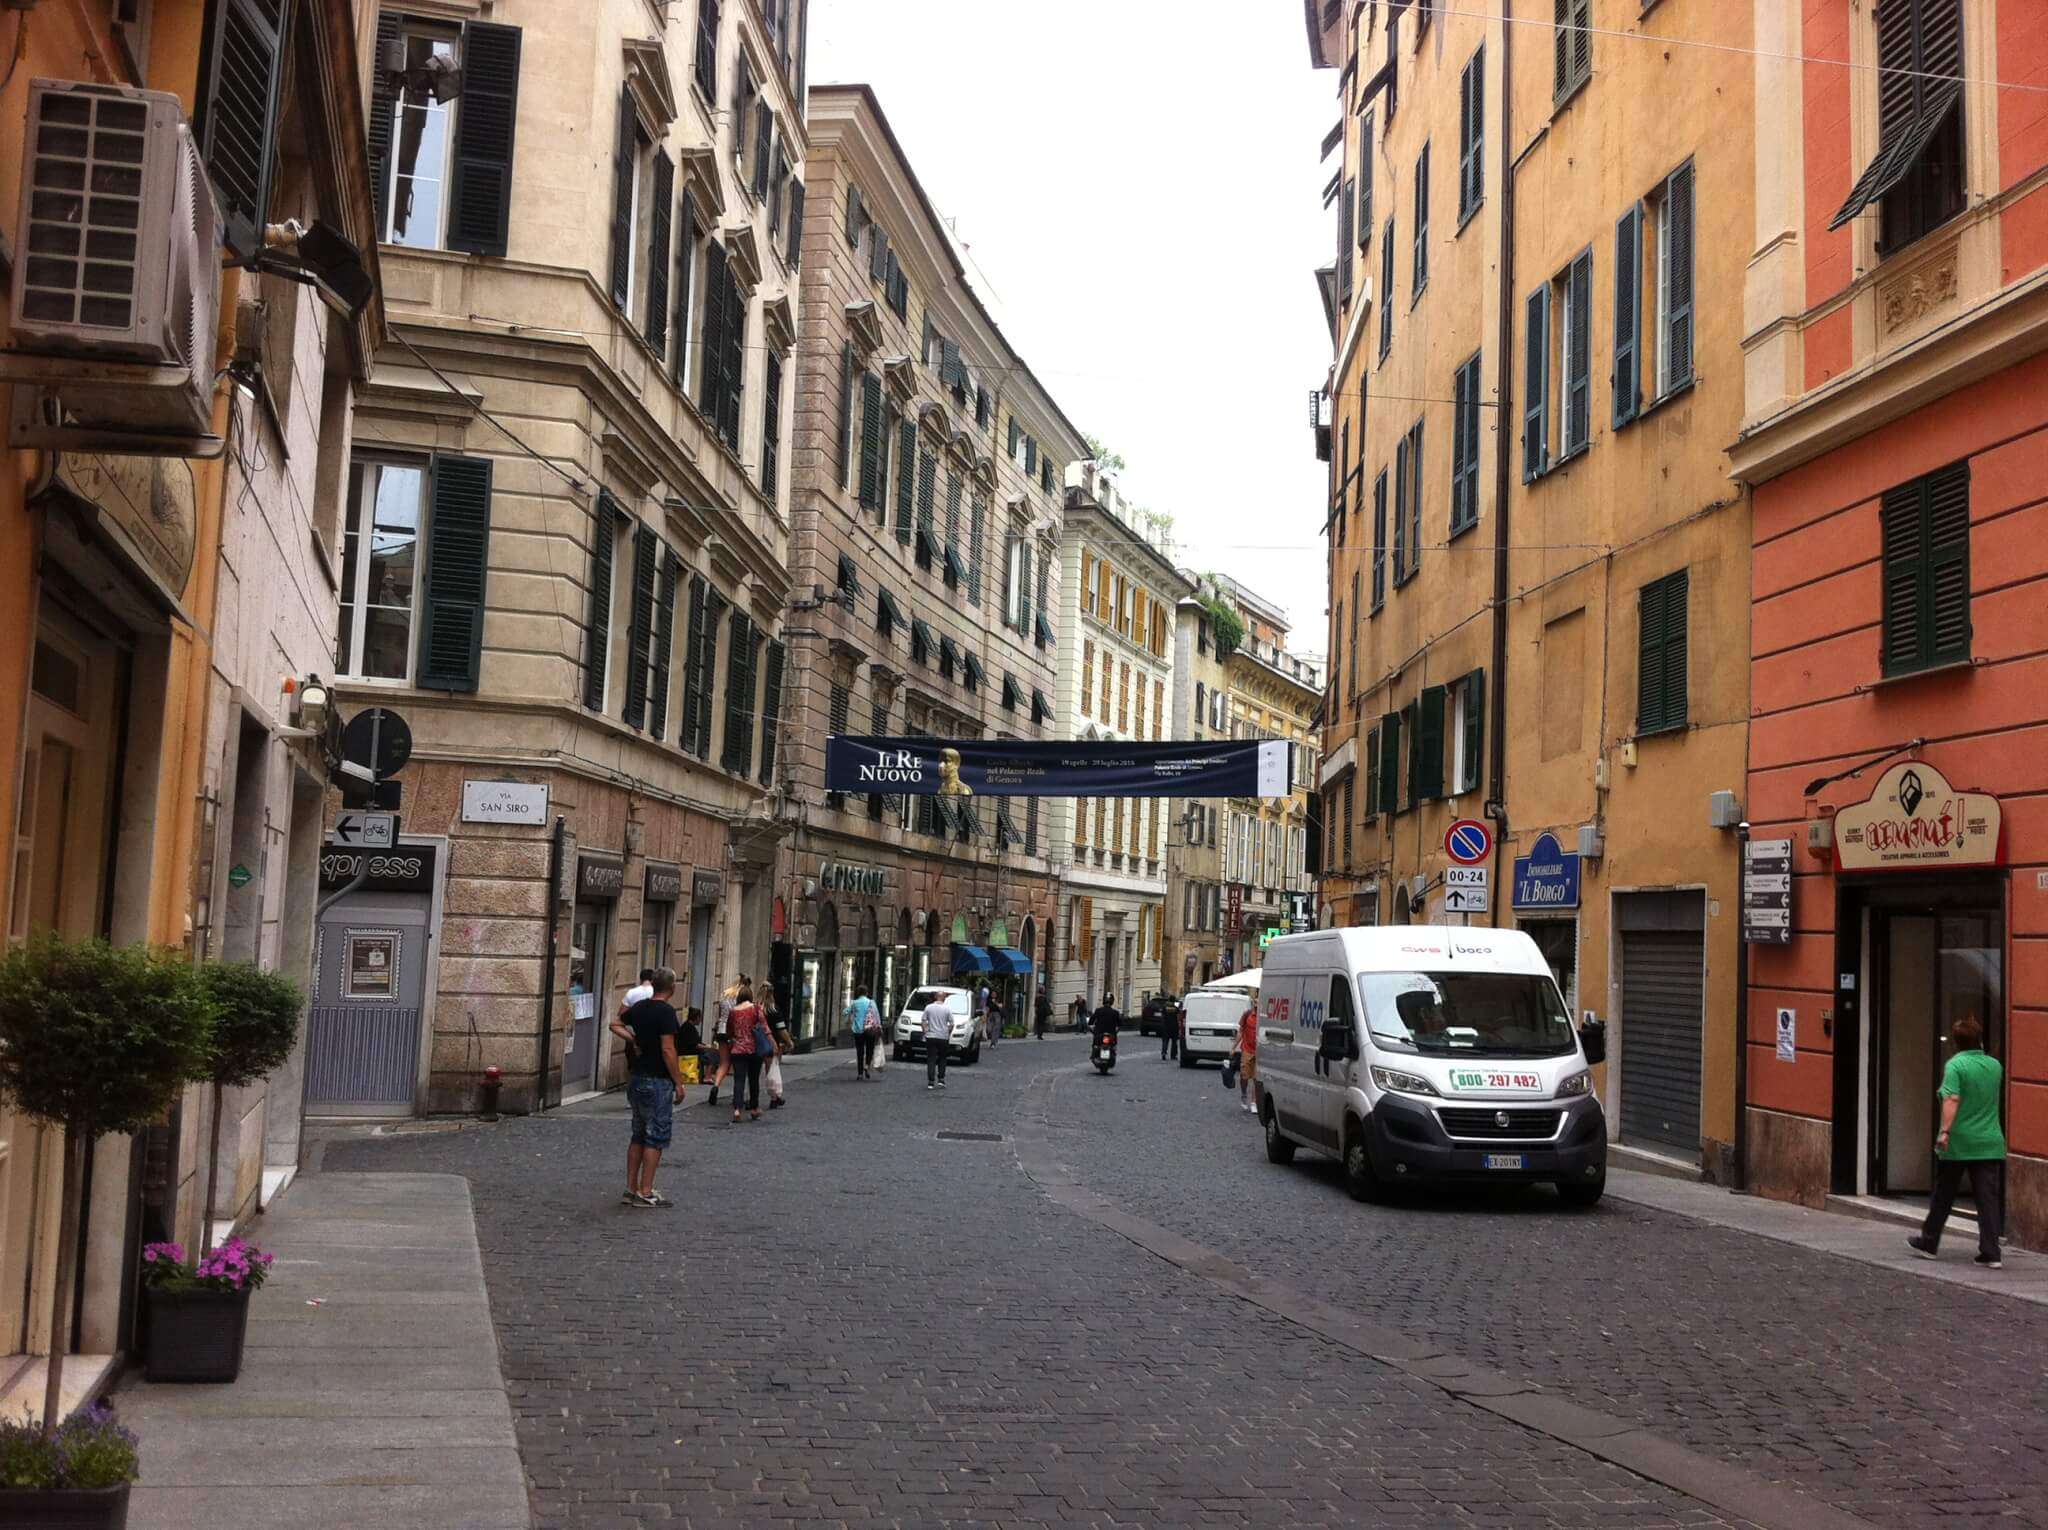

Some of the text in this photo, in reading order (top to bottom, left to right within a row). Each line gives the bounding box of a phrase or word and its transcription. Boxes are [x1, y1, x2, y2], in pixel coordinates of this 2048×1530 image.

[499, 792, 512, 800] VIA
[480, 802, 530, 814] SAN SIRO
[1449, 870, 1483, 883] 00-24
[1455, 943, 1492, 954] boco
[1513, 1074, 1538, 1088] 482
